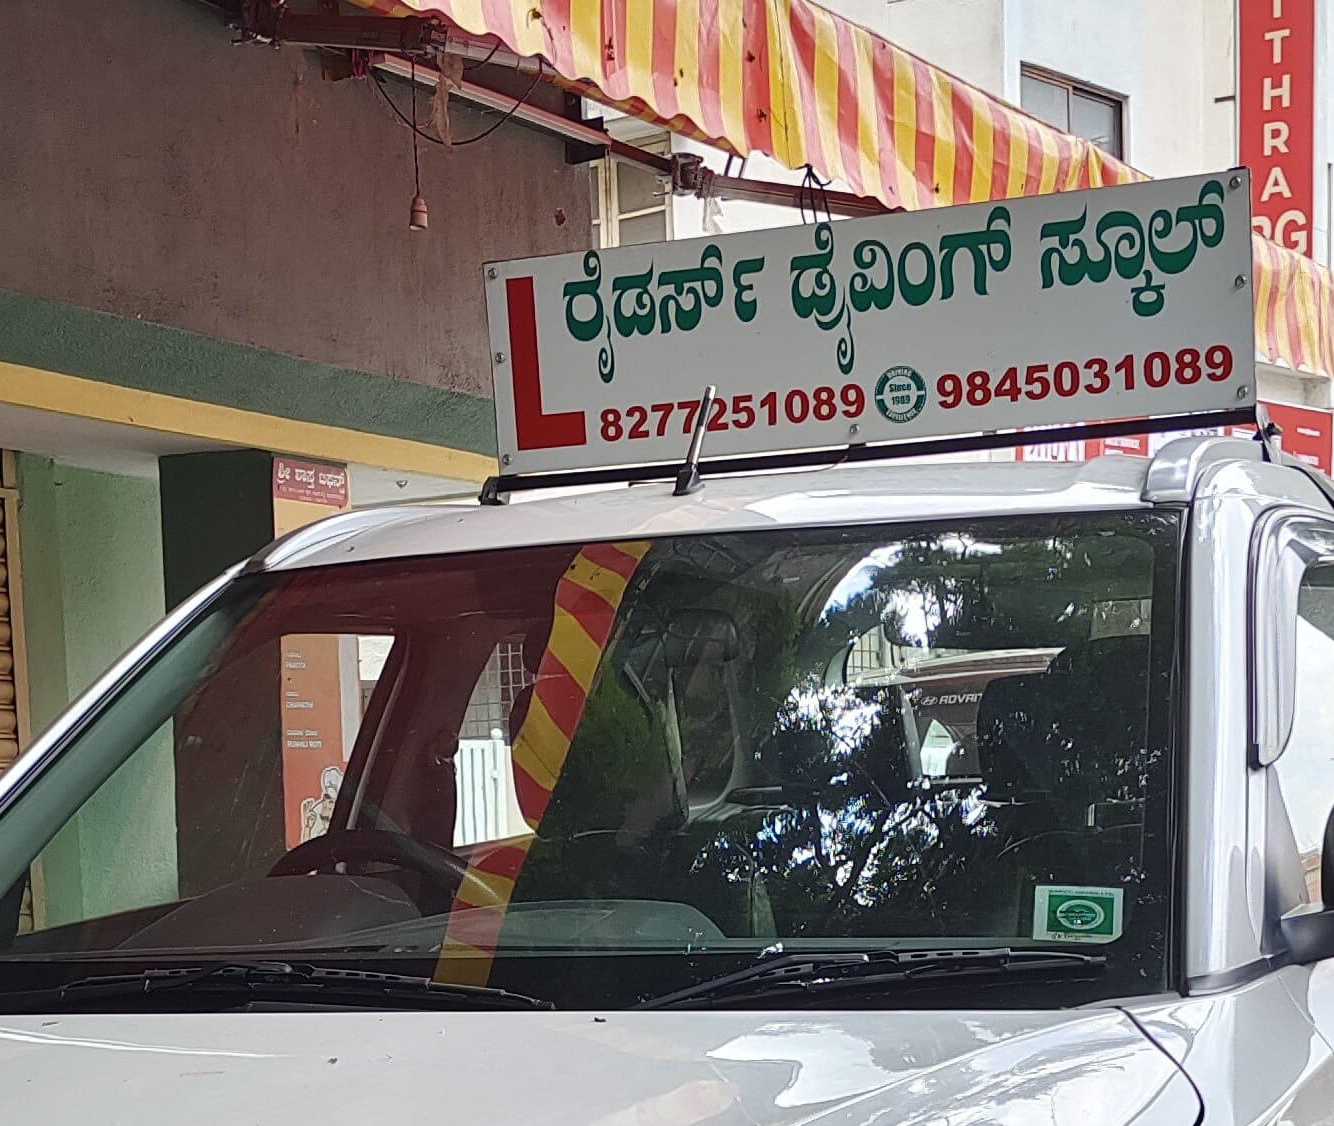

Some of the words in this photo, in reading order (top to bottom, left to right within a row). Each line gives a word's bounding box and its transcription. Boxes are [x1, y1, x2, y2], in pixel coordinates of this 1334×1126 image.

[563, 250, 765, 383] ರೈಡರ್ಸ್
[790, 205, 1011, 376] ಡ್ರೈವಿಂಗ್
[1040, 180, 1225, 317] ಸ್ಕೂಲ್
[506, 276, 587, 450] L
[600, 383, 866, 442] 8277251089
[936, 345, 1234, 410] 9845031089
